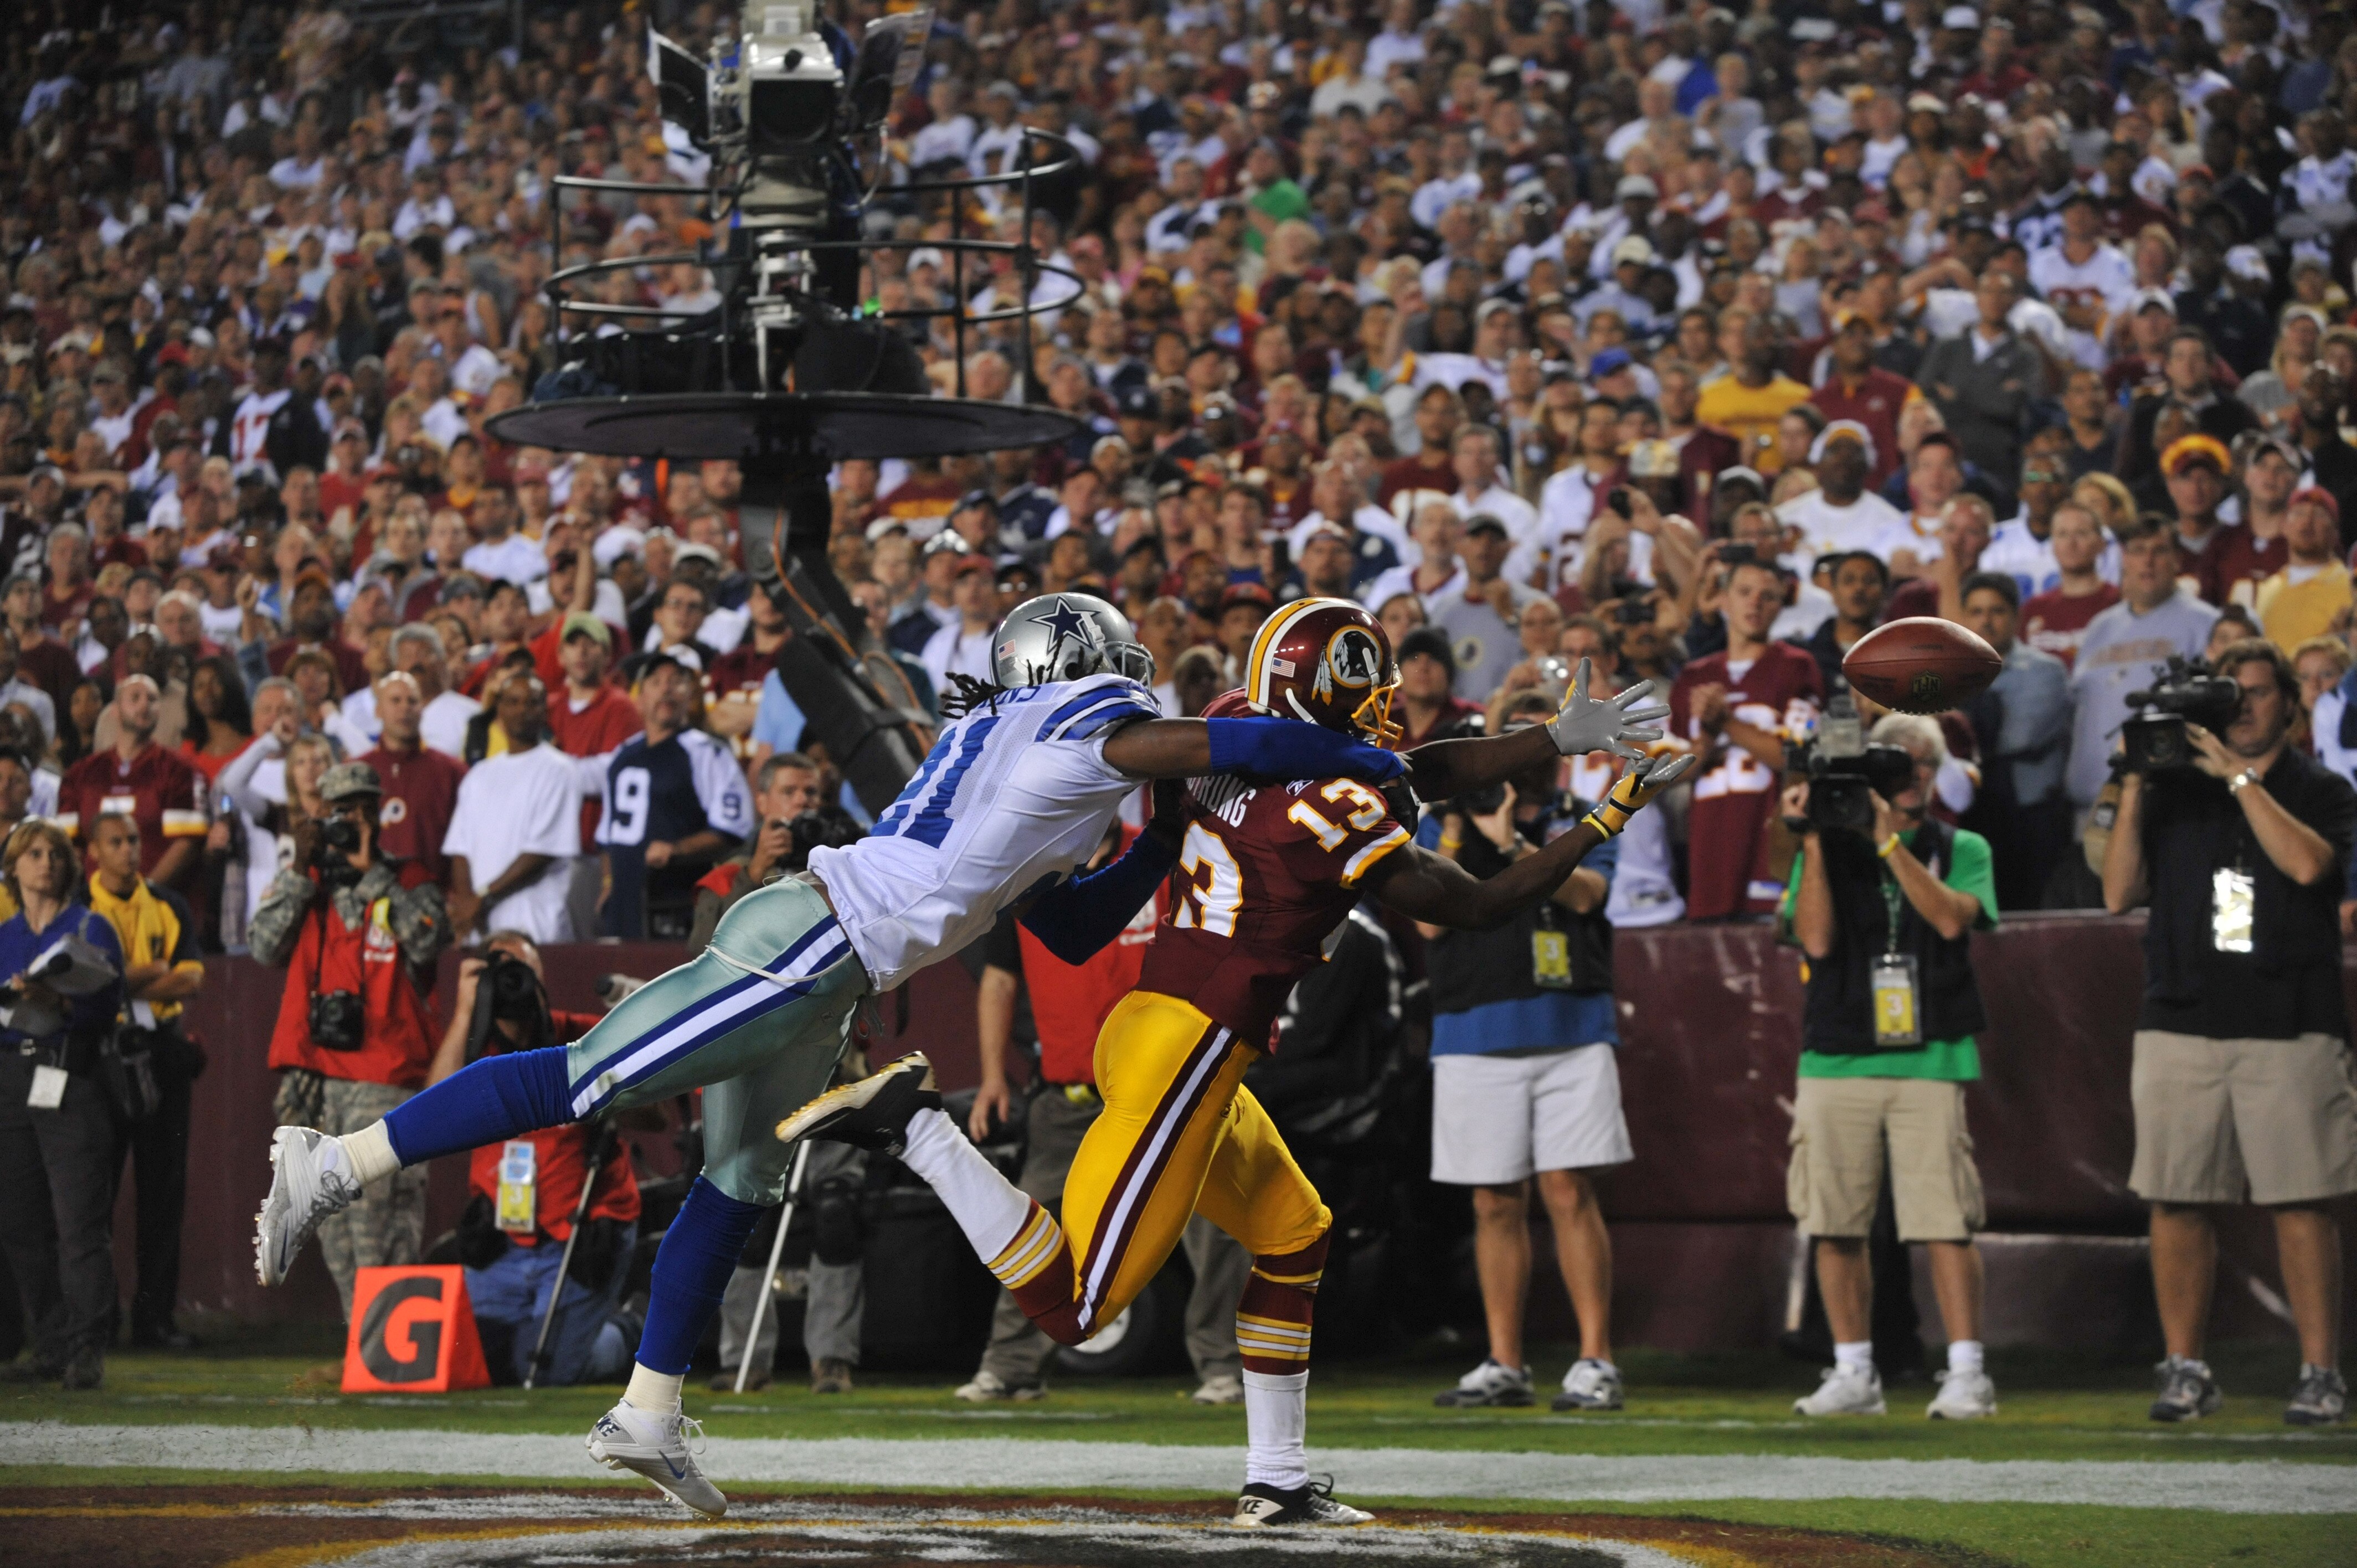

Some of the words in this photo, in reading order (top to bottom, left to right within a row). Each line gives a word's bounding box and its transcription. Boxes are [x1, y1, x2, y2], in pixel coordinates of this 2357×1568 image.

[609, 764, 652, 847] 9
[1288, 777, 1386, 853] 13
[1886, 994, 1903, 1017] 3
[359, 1276, 445, 1384] G
